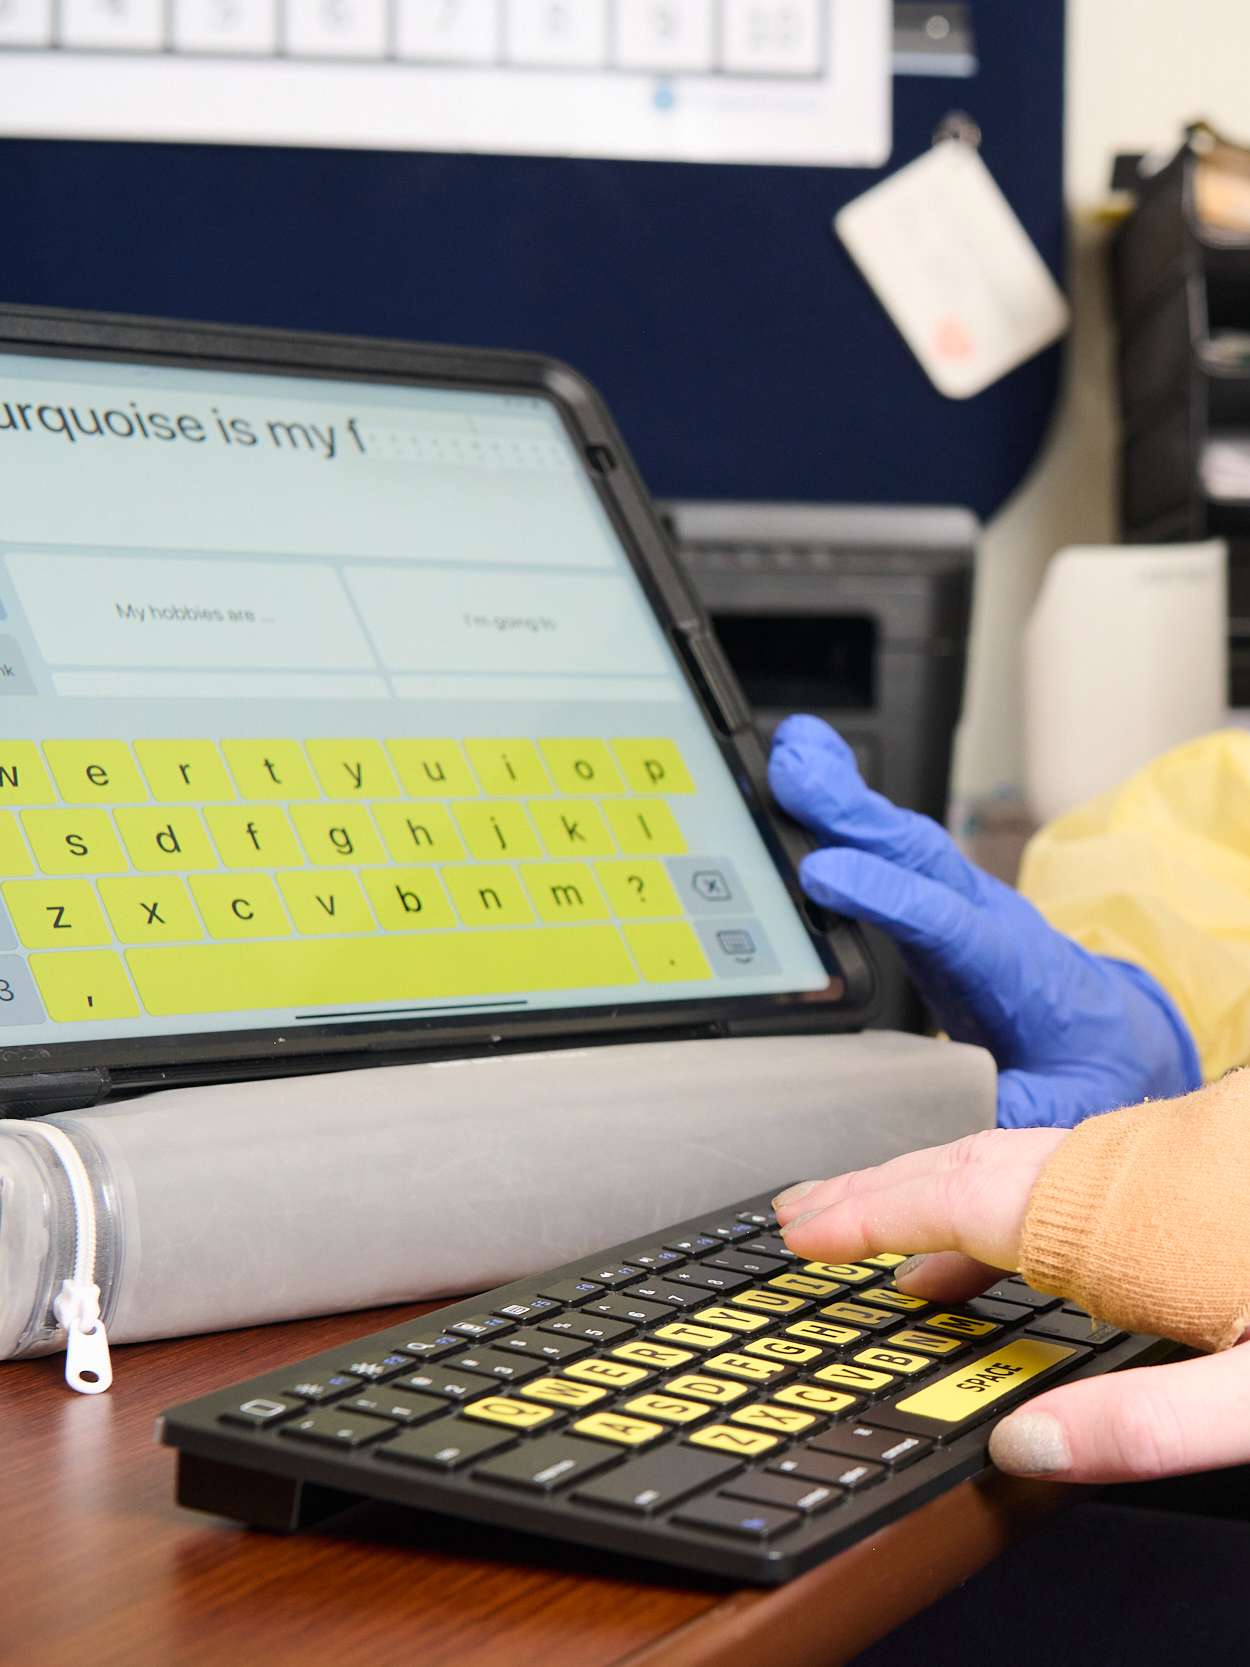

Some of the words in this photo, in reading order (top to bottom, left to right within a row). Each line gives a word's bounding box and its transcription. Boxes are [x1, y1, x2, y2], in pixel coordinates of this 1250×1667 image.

[211, 407, 258, 447] is
[266, 420, 337, 459] my
[115, 602, 146, 622] My
[148, 603, 225, 623] hobbies
[227, 608, 256, 623] are
[85, 764, 110, 787] e
[178, 763, 191, 785] r
[263, 758, 281, 785] t
[343, 762, 363, 789] y
[422, 761, 447, 782] u
[502, 754, 517, 781] i
[573, 759, 595, 781] o
[643, 759, 665, 785] p
[65, 834, 89, 857] s
[155, 824, 182, 854] d
[246, 822, 261, 851] f
[328, 827, 354, 855] g
[406, 818, 434, 846] h
[490, 816, 507, 851] j
[560, 815, 585, 841] k
[46, 906, 73, 929] z
[140, 902, 165, 925] x
[231, 898, 254, 921] c
[315, 895, 335, 916] v
[395, 885, 422, 913] b
[478, 888, 502, 909] n
[550, 884, 584, 907] m
[627, 875, 646, 903] ?
[584, 1328, 604, 1336] 5
[667, 1294, 685, 1302] 7
[482, 1403, 540, 1416] Q
[535, 1382, 589, 1399] W
[584, 1366, 627, 1377] E
[628, 1348, 678, 1361] R
[672, 1328, 712, 1338] T
[711, 1312, 750, 1322] Y
[748, 1295, 789, 1305] U
[787, 1279, 823, 1289] I
[822, 1266, 857, 1274] O
[599, 1422, 643, 1435] A
[648, 1402, 688, 1413] S
[683, 1383, 725, 1394] D
[723, 1359, 760, 1371] F
[764, 1343, 805, 1354] G
[801, 1325, 846, 1337] H
[838, 1307, 875, 1319] J
[712, 1433, 756, 1445] Z
[748, 1410, 797, 1425] X
[796, 1391, 837, 1402] C
[832, 1369, 873, 1380] V
[871, 1353, 912, 1366] B
[904, 1334, 949, 1348] N
[938, 1316, 987, 1331] M
[956, 1362, 1024, 1392] SPACE
